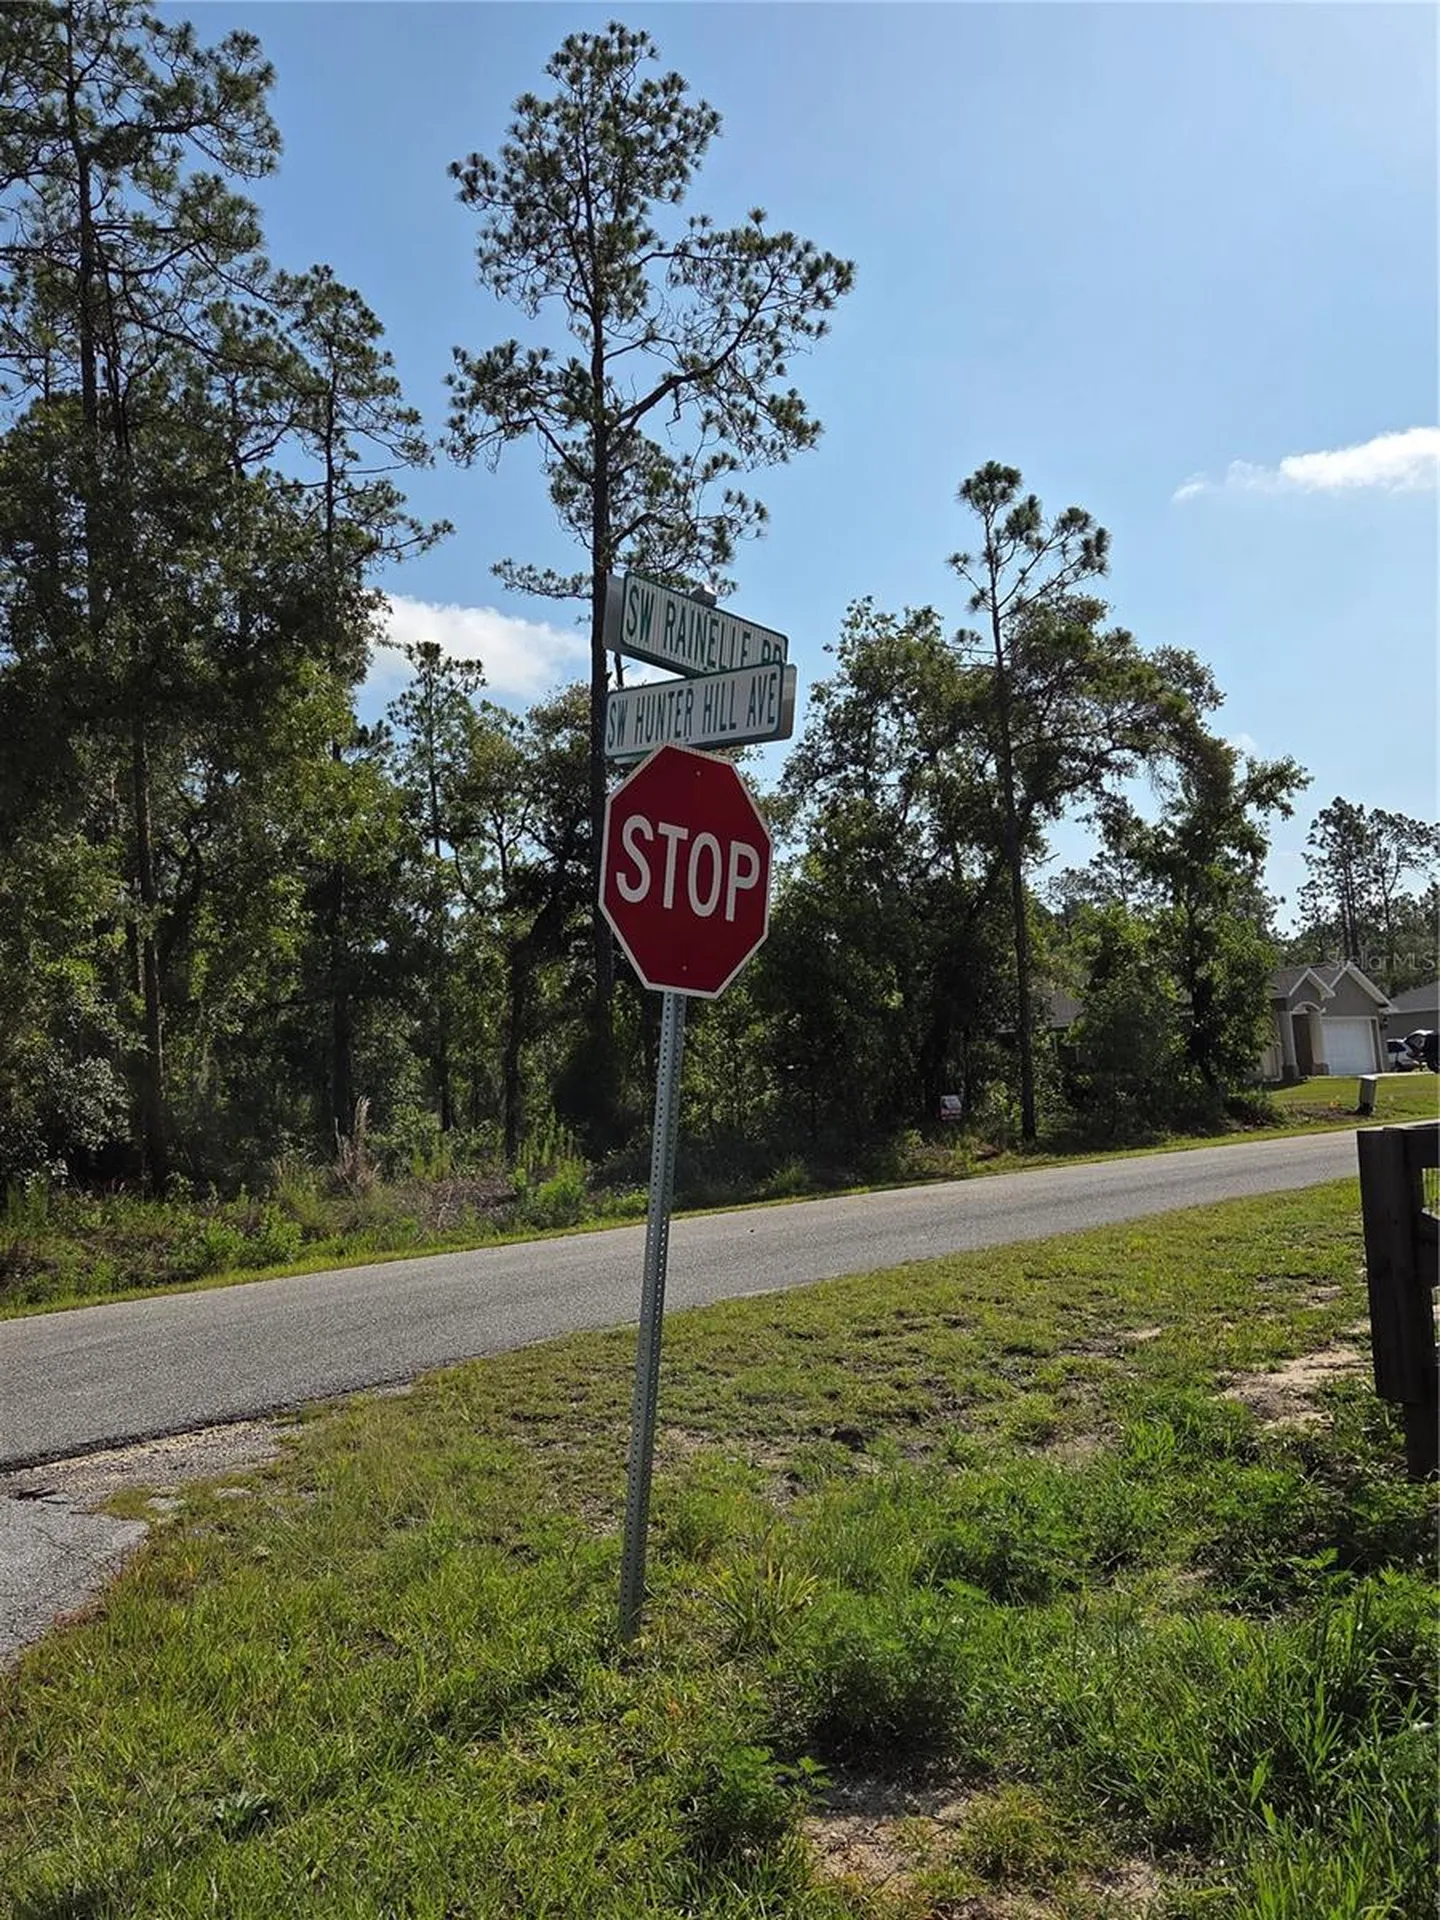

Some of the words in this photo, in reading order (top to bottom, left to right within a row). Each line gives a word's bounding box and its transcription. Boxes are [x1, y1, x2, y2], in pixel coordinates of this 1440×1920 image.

[627, 585, 655, 643] SW
[607, 700, 628, 749] SW
[634, 688, 694, 744] HUNTER
[702, 680, 736, 733] HILL
[747, 672, 777, 728] AVE
[616, 814, 760, 922] STOP
